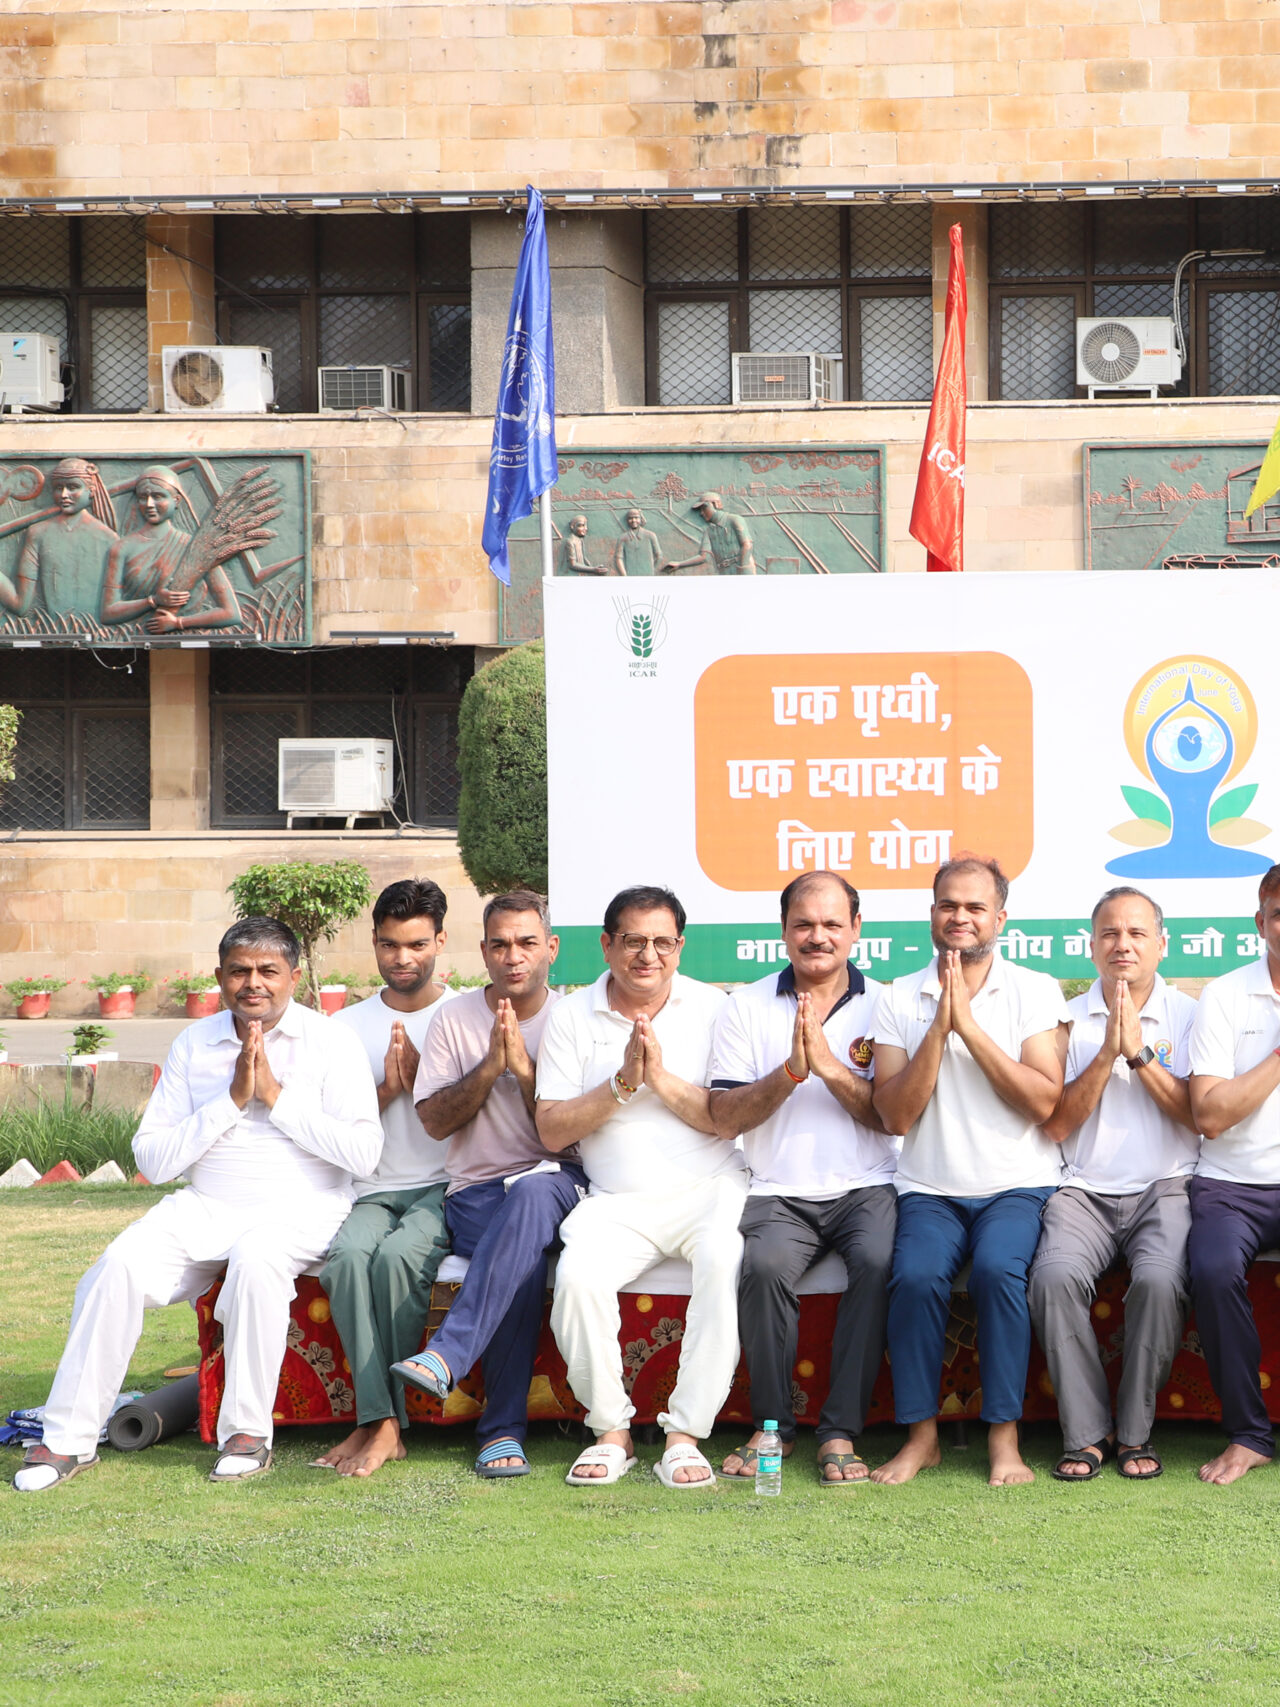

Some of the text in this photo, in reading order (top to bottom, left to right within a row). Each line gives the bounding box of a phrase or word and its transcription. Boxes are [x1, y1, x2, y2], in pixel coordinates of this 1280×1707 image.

[629, 670, 658, 678] ICAR
[1136, 664, 1243, 715] International Day of Yoga
[1197, 688, 1218, 697] June
[771, 671, 952, 738] एक पृथ्वी,
[726, 744, 1003, 799] एक स्वास्थ्य के
[775, 818, 954, 871] लिए योग
[1181, 926, 1226, 958] जौ
